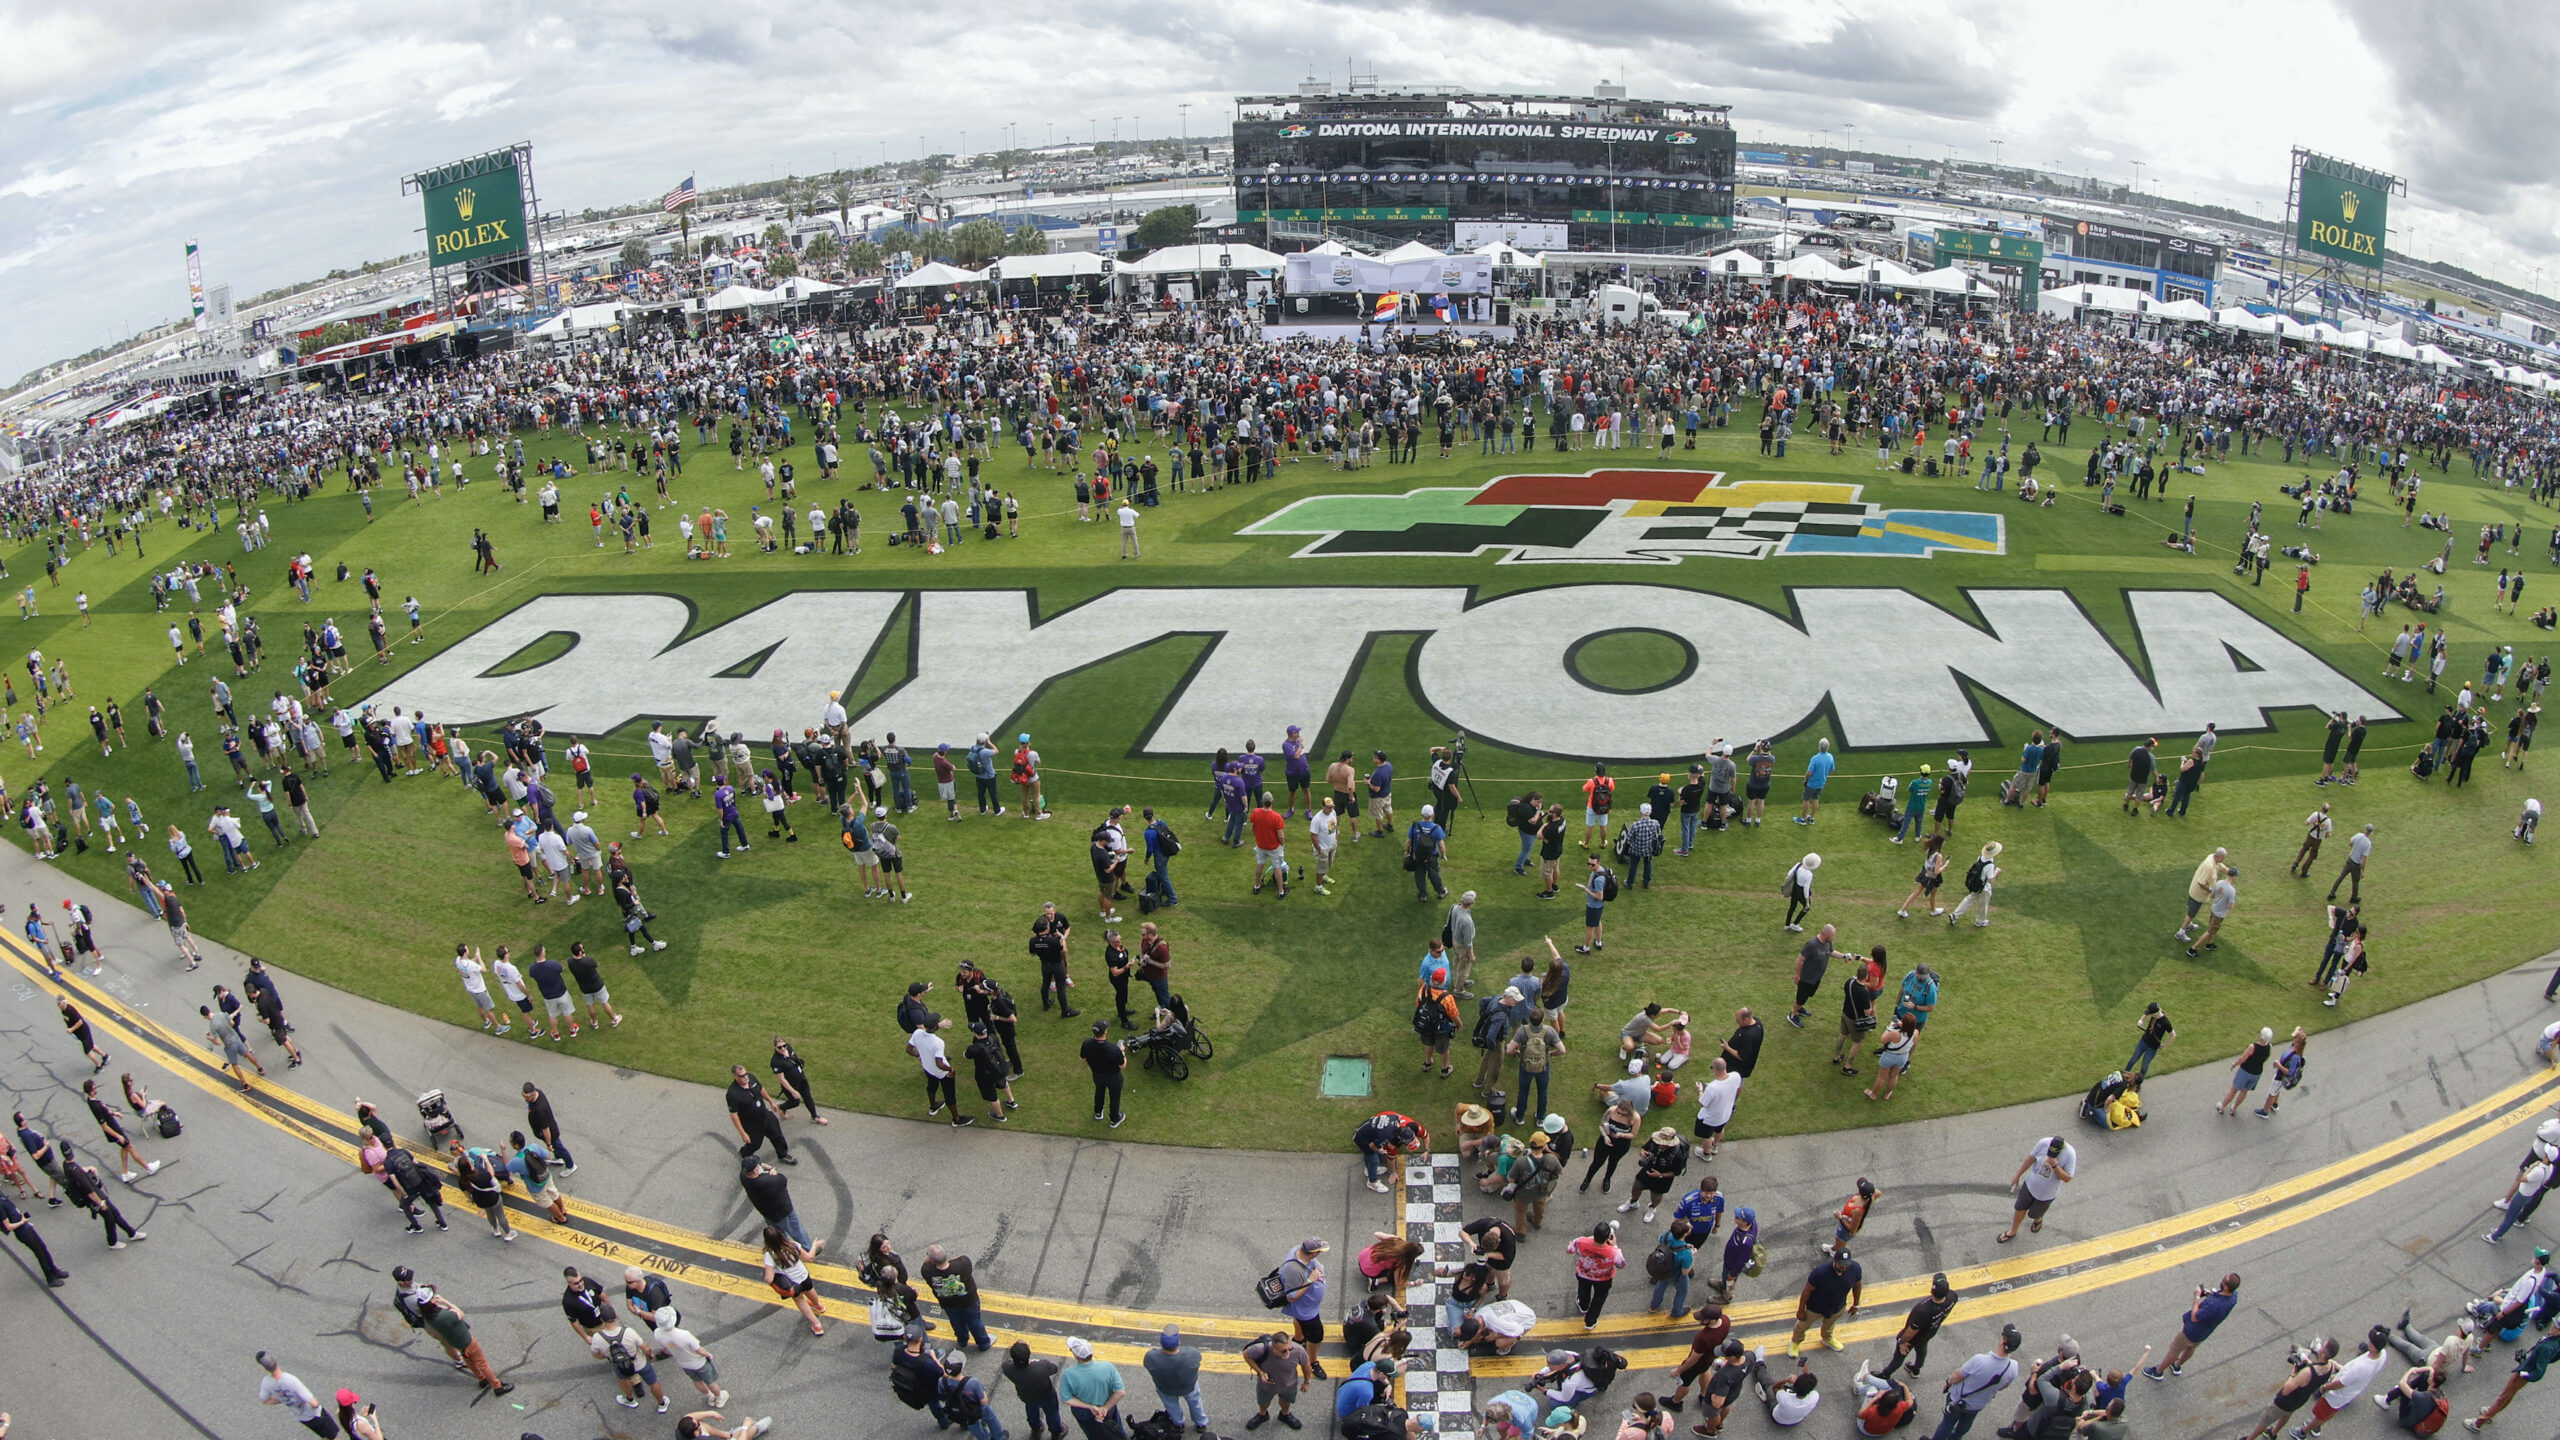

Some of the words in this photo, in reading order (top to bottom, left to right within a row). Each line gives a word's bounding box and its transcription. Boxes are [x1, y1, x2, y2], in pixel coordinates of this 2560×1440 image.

[1318, 123, 1401, 137] DAYTONA
[1405, 123, 1555, 138] INTERNATIONAL
[1560, 126, 1659, 142] SPEEDWAY
[434, 219, 510, 255] ROLEX
[1218, 228, 1237, 236] Mobil
[2089, 224, 2107, 234] Shop
[2309, 219, 2377, 256] ROLEX
[1810, 237, 1827, 245] Mobil
[2176, 276, 2206, 287] CHEVROLET
[344, 584, 2411, 763] DAYTONA
[1616, 830, 1627, 855] 3
[639, 1253, 693, 1275] ANDY
